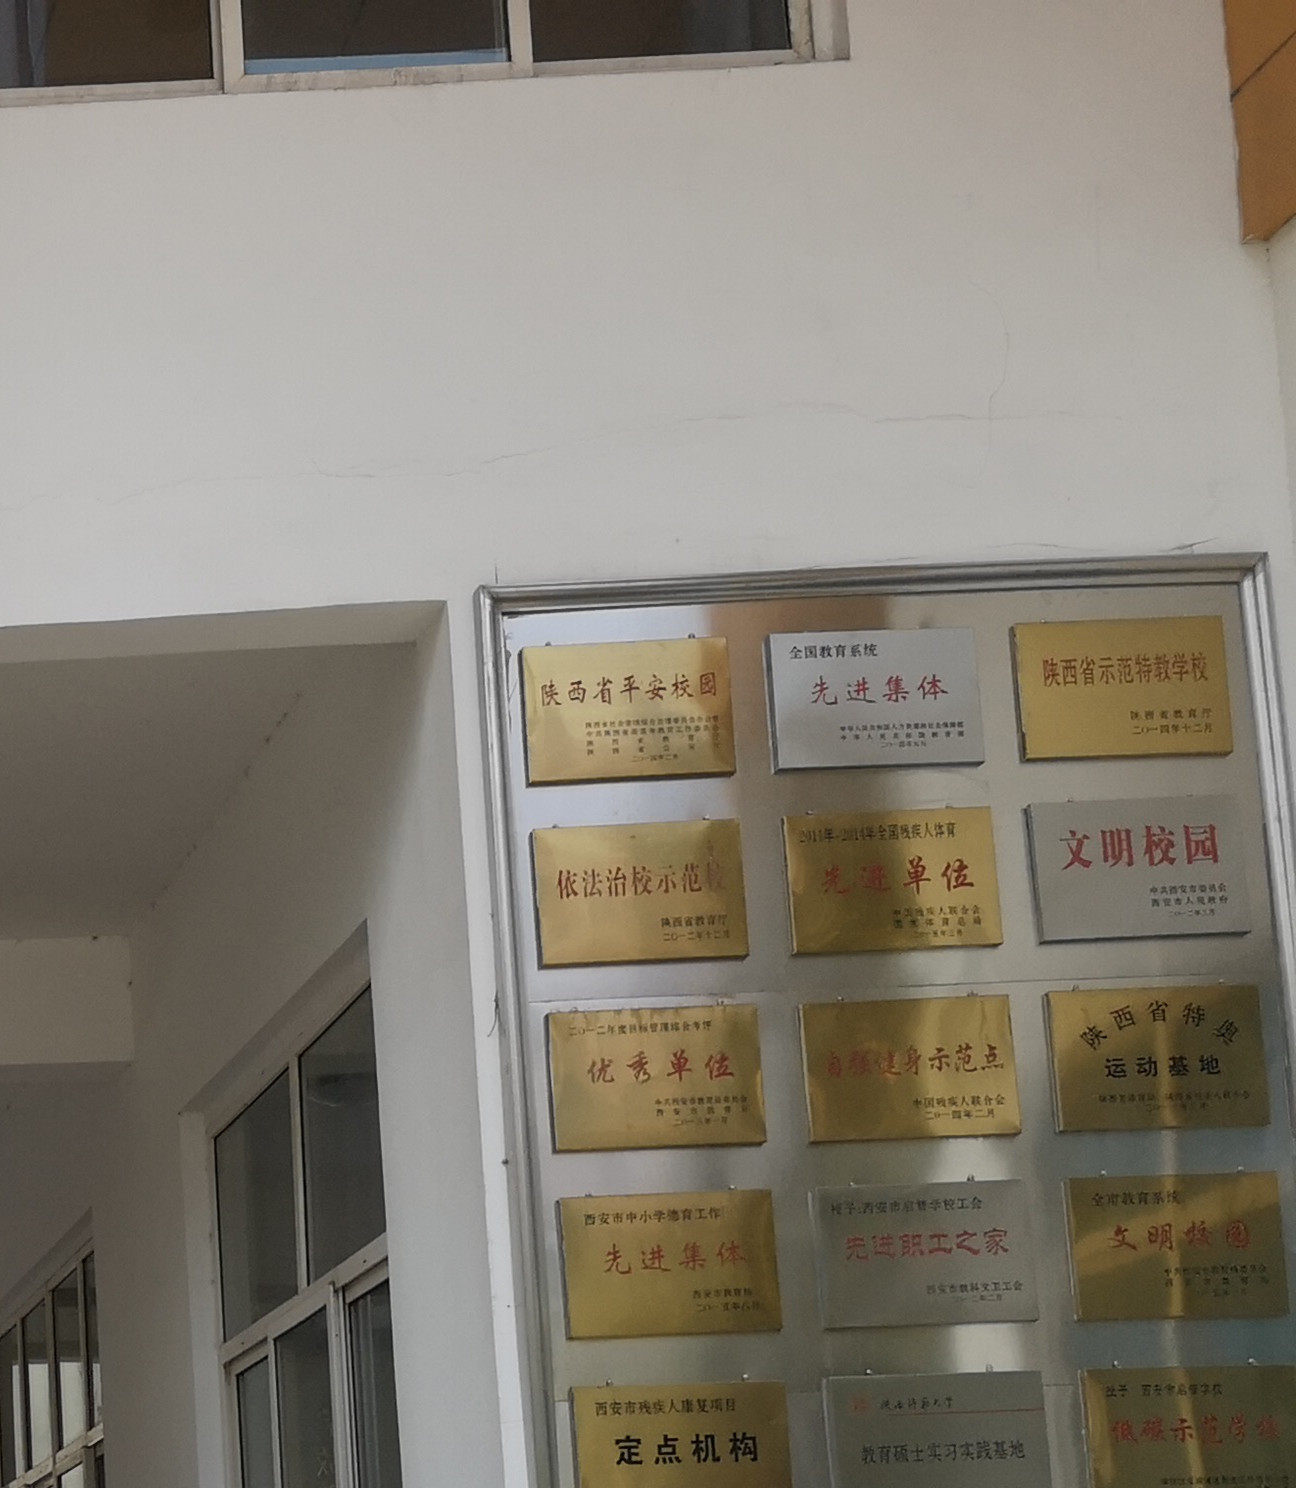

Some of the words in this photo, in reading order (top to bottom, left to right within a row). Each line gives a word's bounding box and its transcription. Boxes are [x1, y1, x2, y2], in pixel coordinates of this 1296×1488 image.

[788, 643, 878, 660] 全国教育系统
[1042, 650, 1209, 688] 陕西省示范特教学校
[540, 671, 718, 707] 陕西省平安校园
[810, 674, 950, 706] 先进集体
[1129, 707, 1213, 722] 陕西省教育厅
[1059, 823, 1219, 871] 文明校园
[556, 862, 726, 900] 依法治校示范校
[660, 913, 728, 928] 陕西省教育厅
[1079, 1000, 1240, 1050] 陕西省特奥
[587, 1048, 735, 1085] 优秀单位
[1104, 1053, 1222, 1079] 运动基地
[583, 1205, 722, 1227] 西安市中小学德育工作
[845, 1227, 1010, 1262] 先进职工之家
[1107, 1219, 1252, 1252] 文明校园
[603, 1240, 747, 1276] 先进集体
[594, 1398, 736, 1418] 西安市残疾人康复项目
[614, 1432, 759, 1466] 定点机构
[861, 1440, 1026, 1465] 教育硕士实习实践基地
